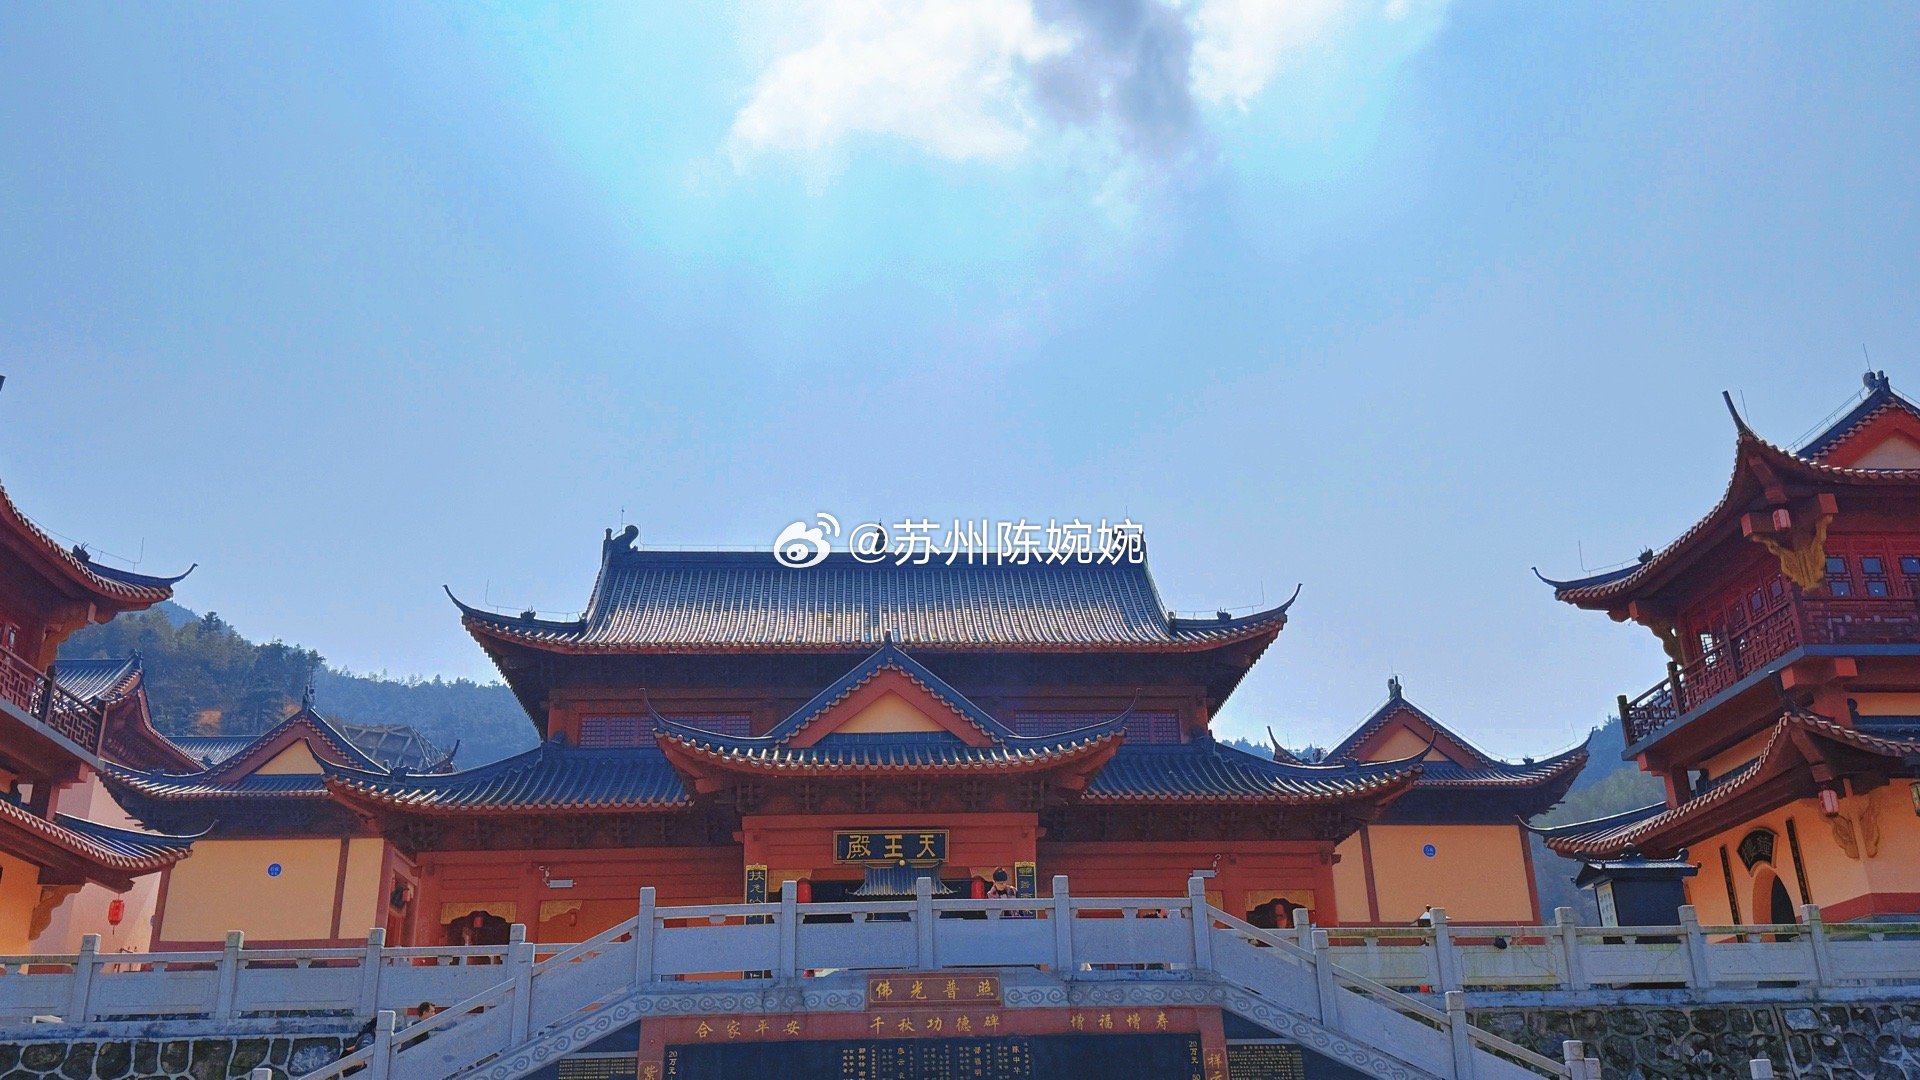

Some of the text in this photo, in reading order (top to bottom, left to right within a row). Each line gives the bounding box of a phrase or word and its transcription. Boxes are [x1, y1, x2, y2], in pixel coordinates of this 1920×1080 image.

[876, 979, 994, 1000] 佛光普照
[695, 1019, 801, 1039] 合家平安
[870, 1014, 1000, 1035] 千秋功德碑
